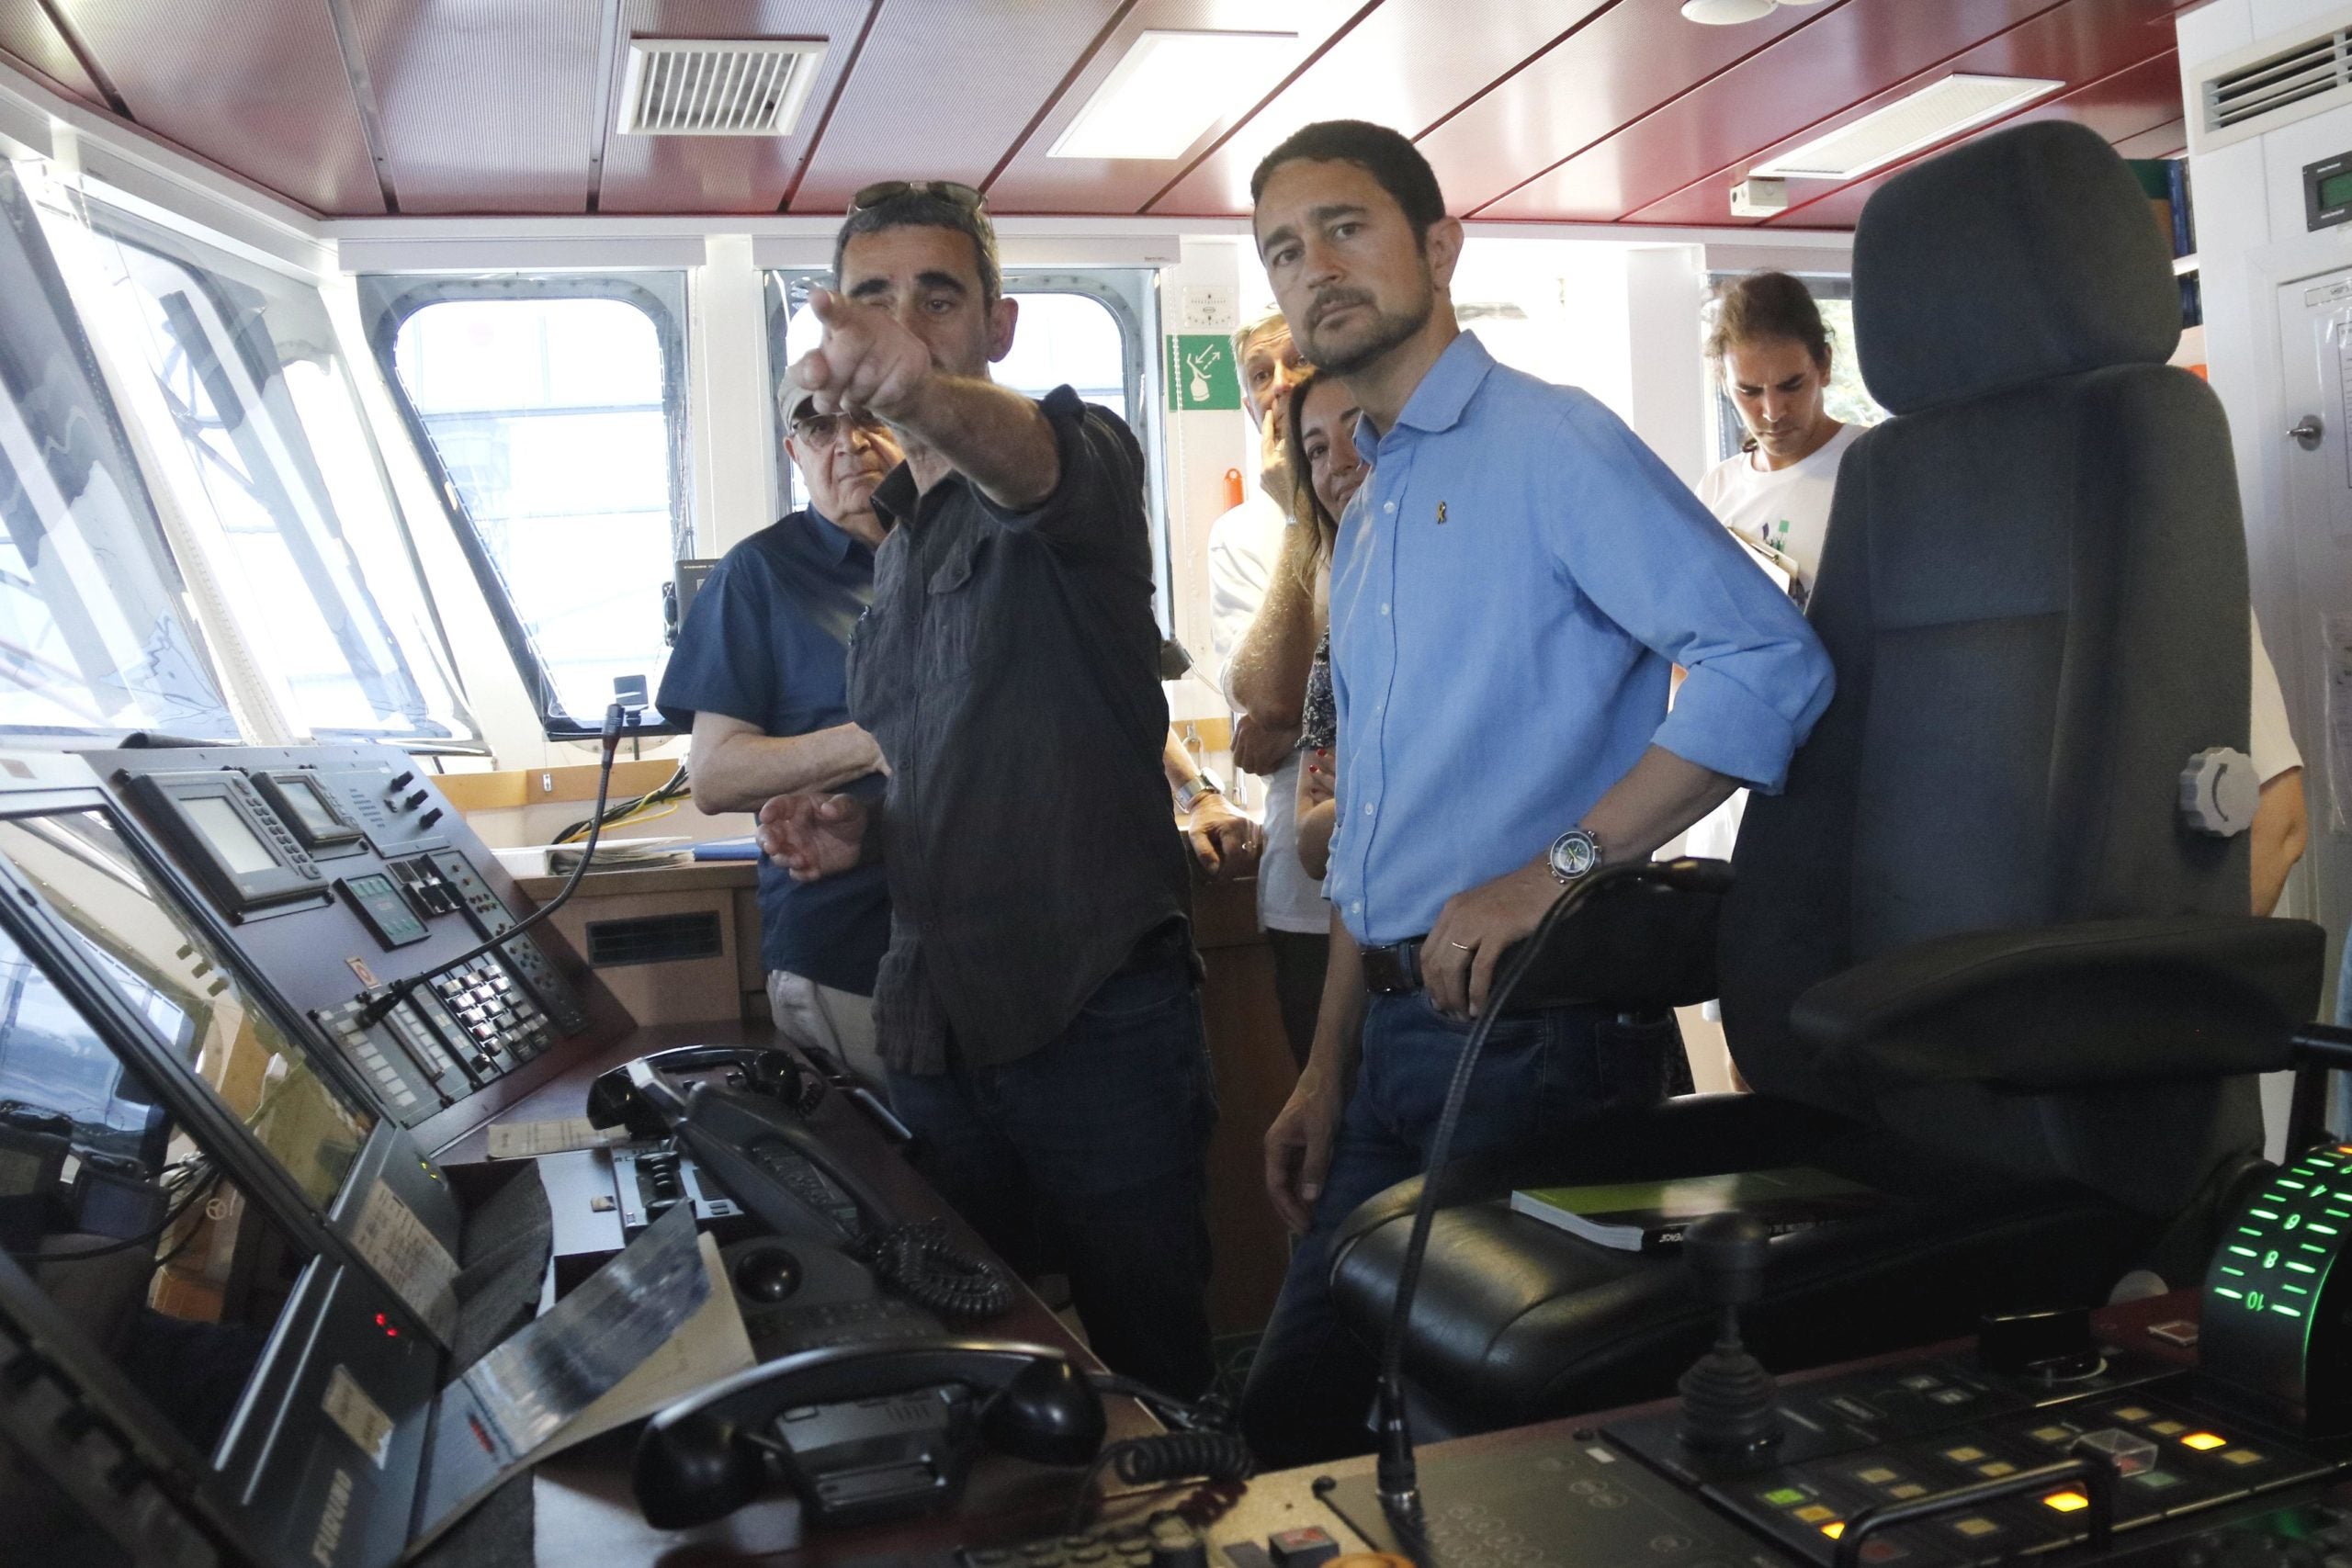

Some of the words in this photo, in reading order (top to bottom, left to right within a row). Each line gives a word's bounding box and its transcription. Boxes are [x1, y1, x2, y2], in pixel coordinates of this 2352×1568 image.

[2309, 1183, 2328, 1198] 4
[2283, 1213, 2301, 1231] 6
[2263, 1249, 2279, 1269] 8
[2245, 1290, 2265, 1312] 10
